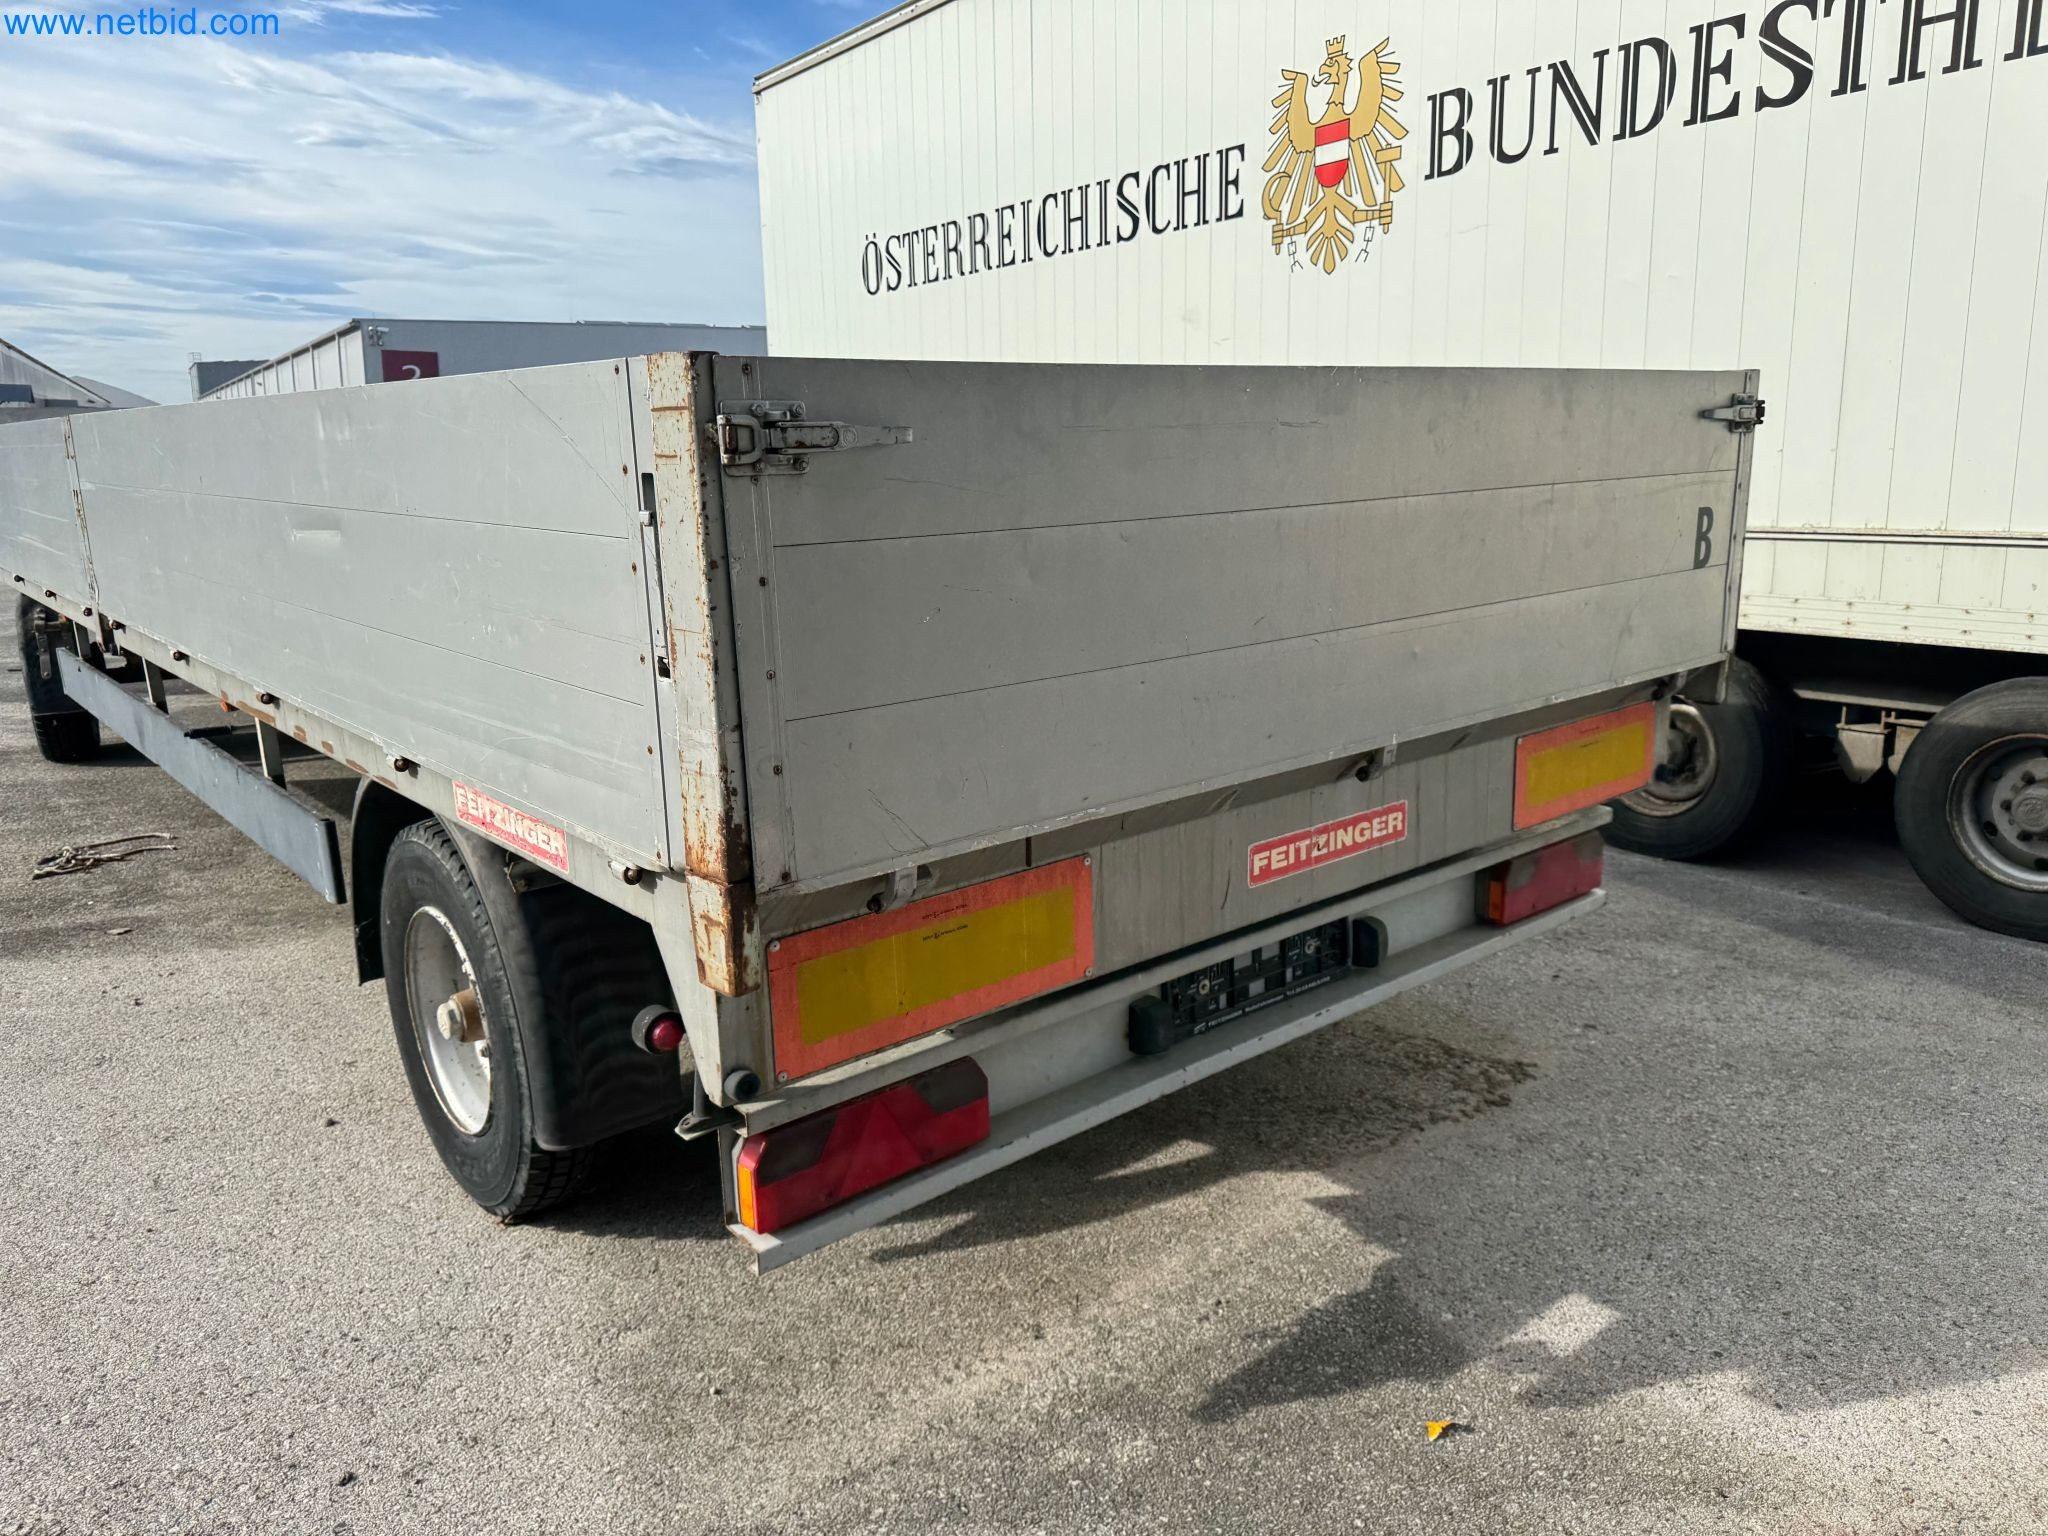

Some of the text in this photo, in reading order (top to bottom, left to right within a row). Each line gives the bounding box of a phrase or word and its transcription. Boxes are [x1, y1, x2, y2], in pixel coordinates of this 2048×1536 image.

[862, 0, 2048, 297] ÖSTERREICHISCHE BUNDESTH
[1693, 506, 1714, 570] B
[456, 784, 566, 859] FEITZINGER
[1253, 811, 1403, 876] FEITZINGER
